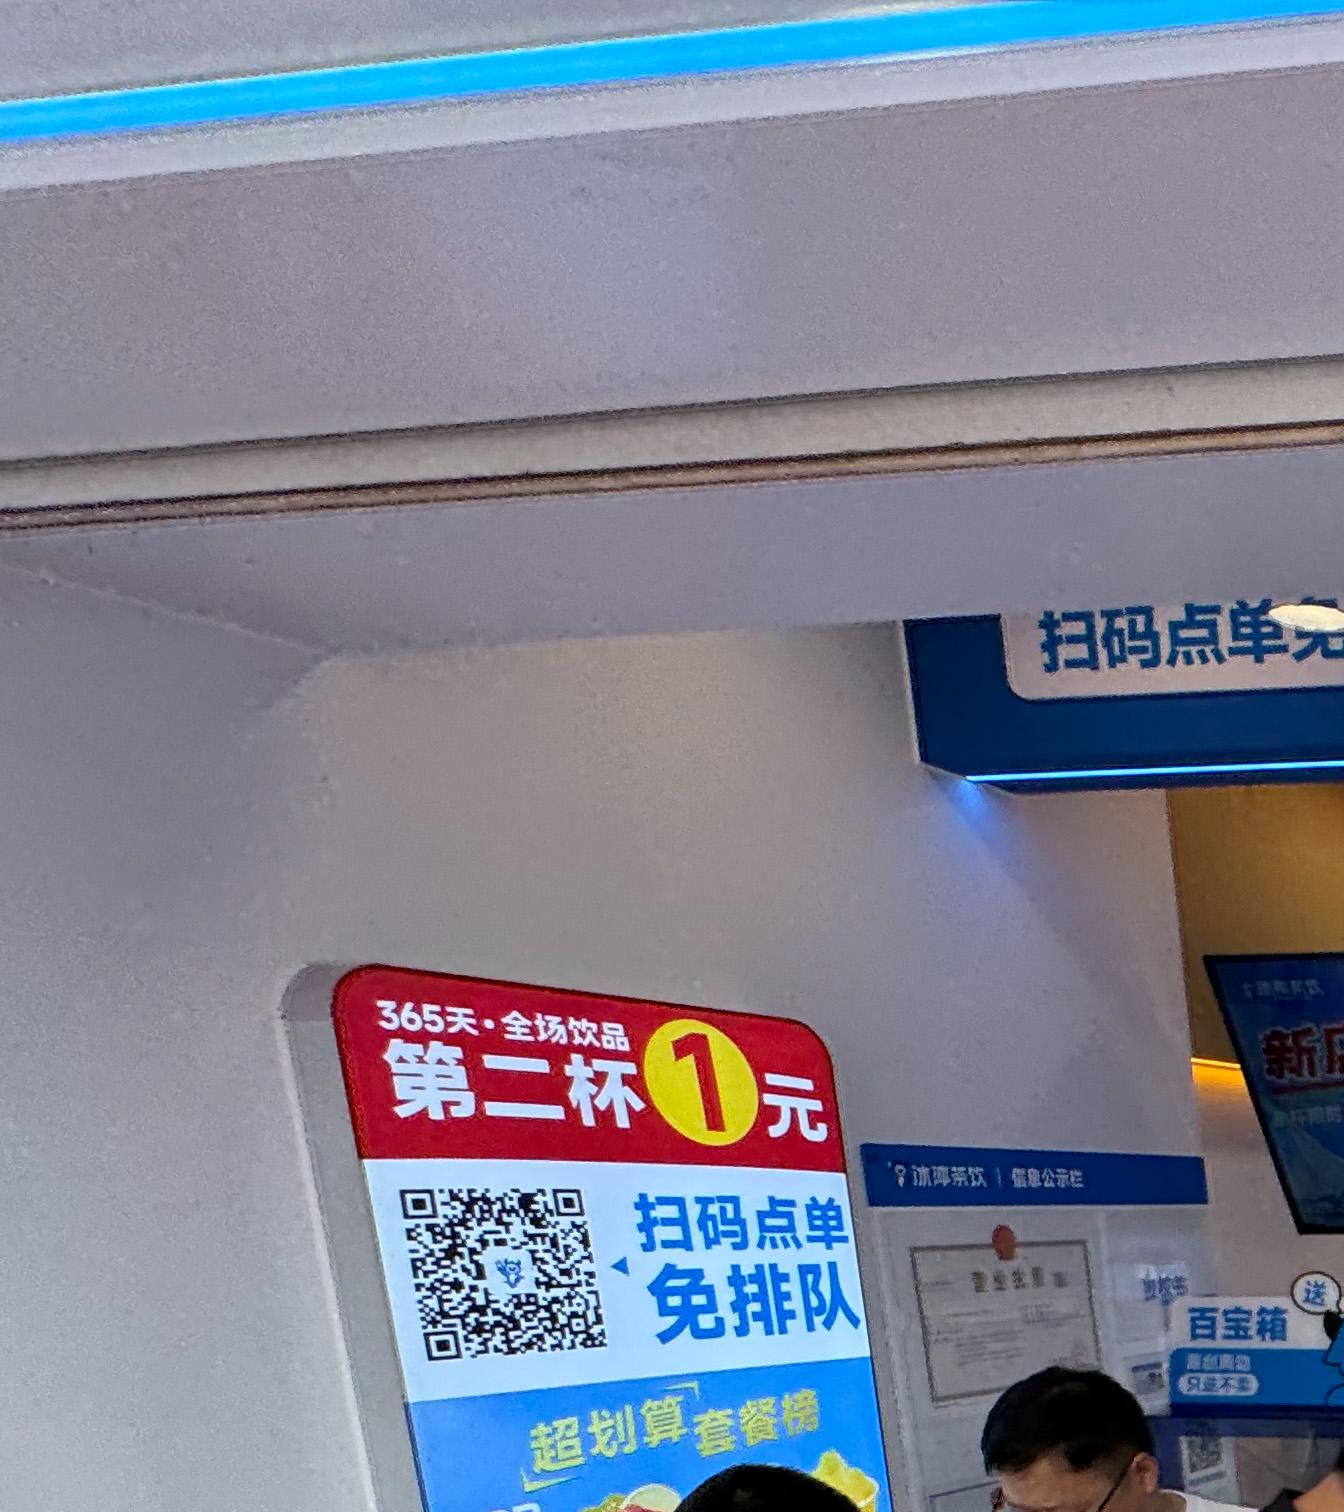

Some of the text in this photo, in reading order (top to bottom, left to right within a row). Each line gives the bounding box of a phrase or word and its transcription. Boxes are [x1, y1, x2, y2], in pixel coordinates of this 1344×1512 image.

[376, 1000, 631, 1053] 365天·全场饮品
[634, 1193, 850, 1254] 扫码点单
[647, 1261, 862, 1345] 免排队
[1302, 1279, 1327, 1305] 送
[1187, 1305, 1289, 1342] 百宝箱
